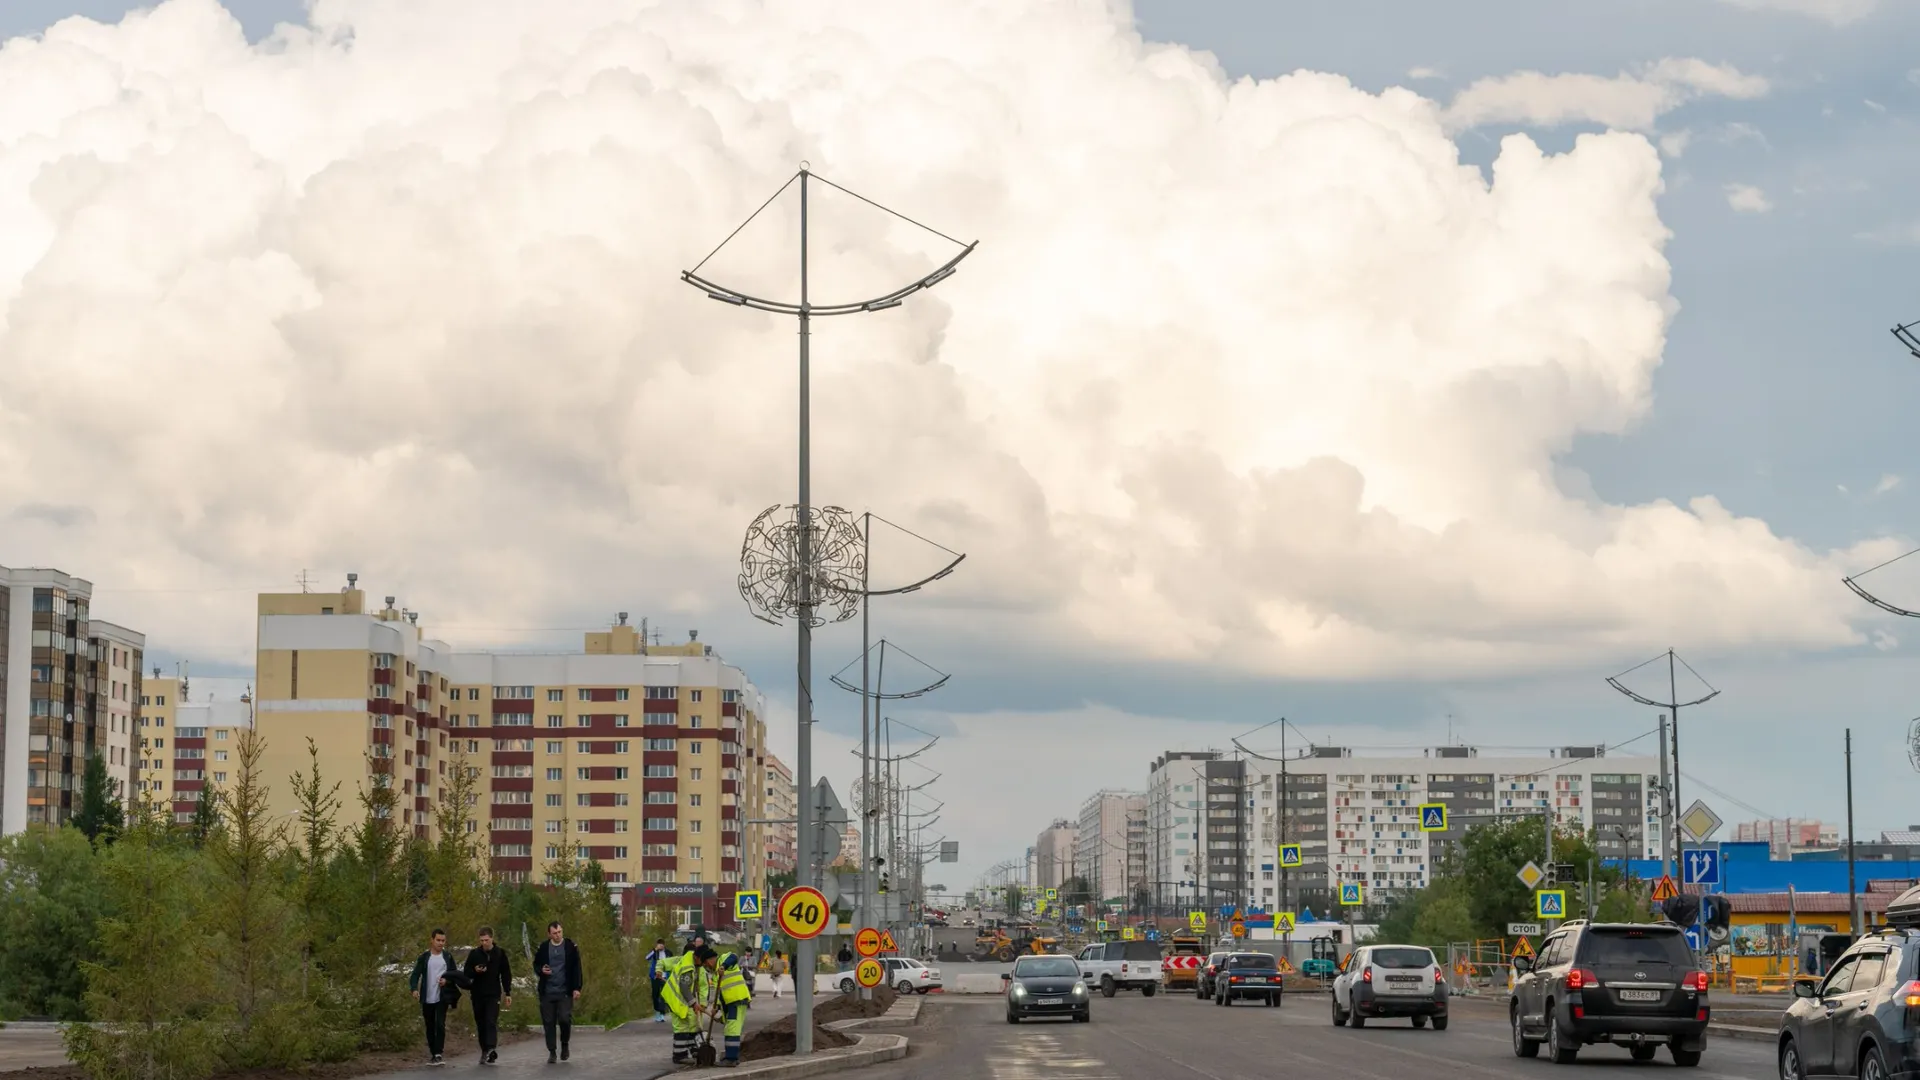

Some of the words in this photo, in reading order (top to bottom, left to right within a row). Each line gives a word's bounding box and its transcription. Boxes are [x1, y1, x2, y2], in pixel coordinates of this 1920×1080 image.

[789, 901, 819, 925] 40
[1512, 925, 1536, 933] СТОП
[863, 966, 877, 979] 20
